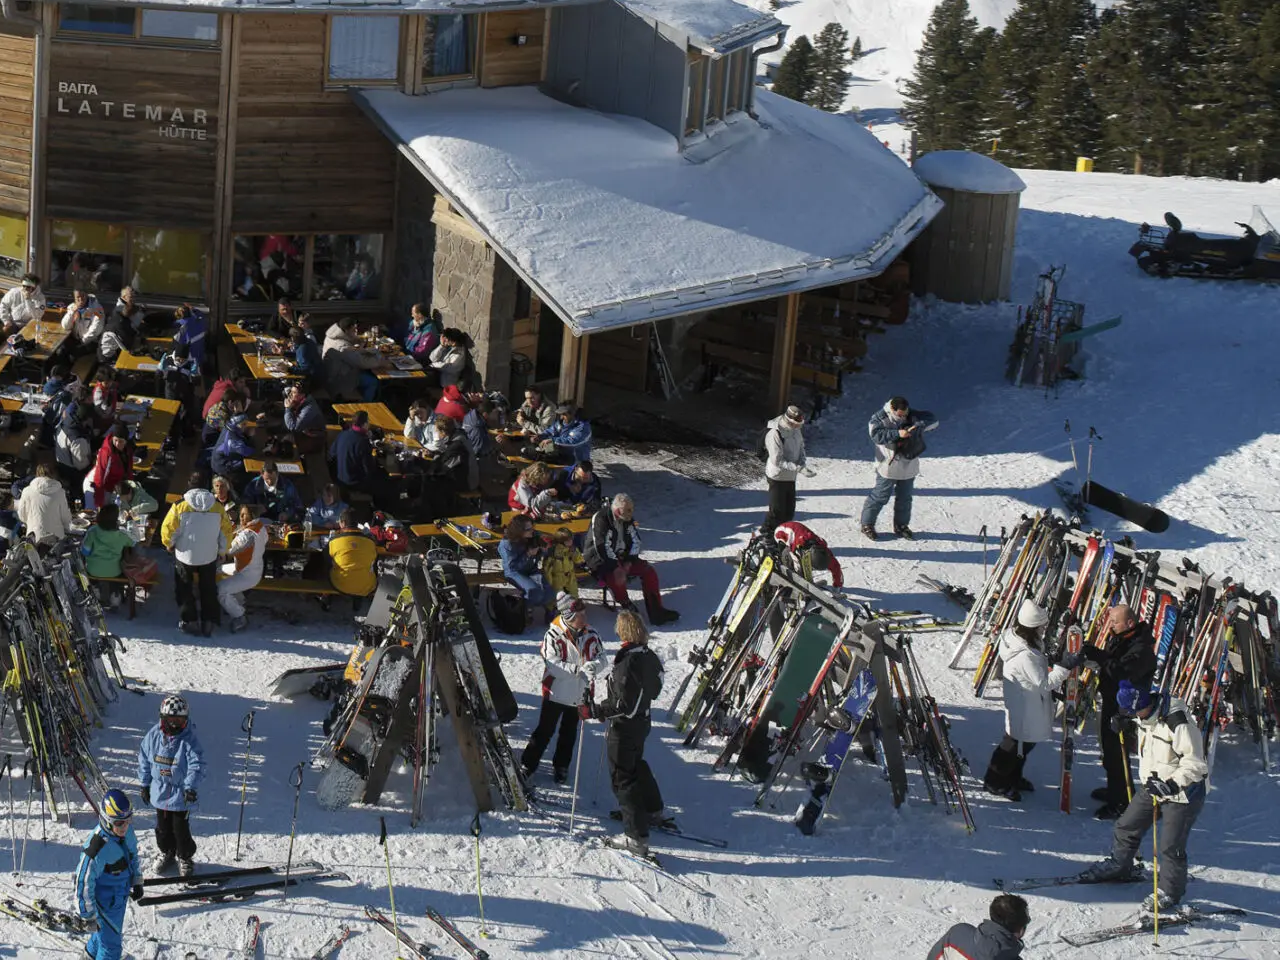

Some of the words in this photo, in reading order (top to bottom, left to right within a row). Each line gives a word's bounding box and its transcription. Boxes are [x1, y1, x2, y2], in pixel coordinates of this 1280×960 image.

[58, 81, 98, 95] BAITA
[57, 97, 207, 124] LATEMAR
[159, 124, 207, 141] HÜTTE
